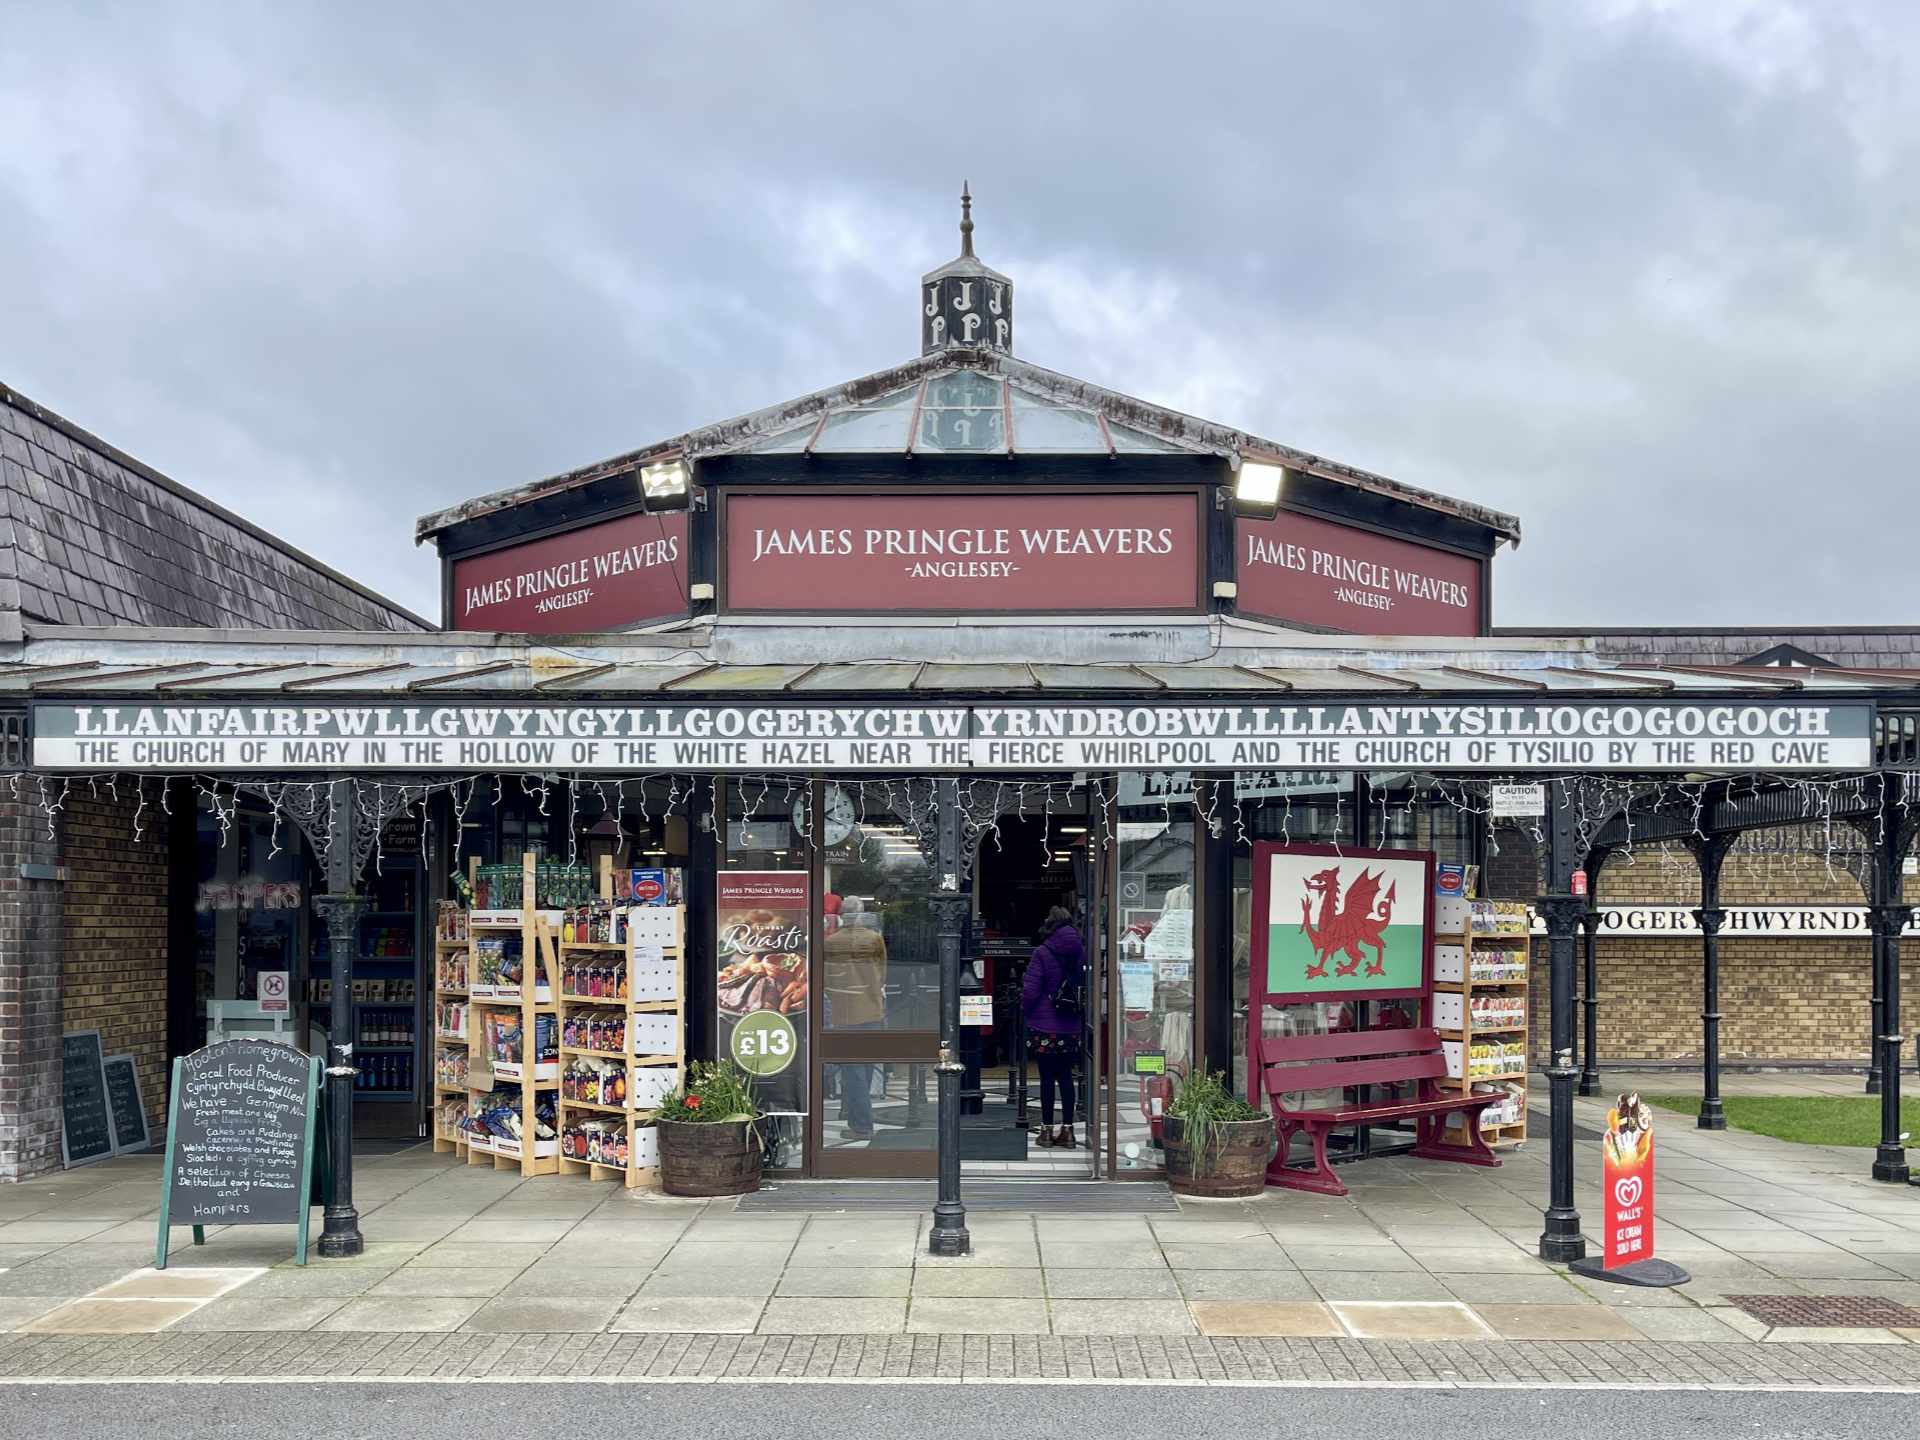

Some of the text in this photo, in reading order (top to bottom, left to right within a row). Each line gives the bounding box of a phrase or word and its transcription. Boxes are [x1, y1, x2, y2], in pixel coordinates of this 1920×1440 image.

[752, 528, 1173, 562] JAMES PRINGLE WEAVERS
[465, 536, 678, 616] JAMES PRINGLE WEAVERS
[1246, 535, 1468, 608] JAMES PRINGLE WEAVERS
[75, 741, 1830, 764] THE CHURCH OF MARY IN THE HOLLOW OF THE WHITE HAZEL NEAR THE FIERCE WHIRLPOOL AND THE CHURCH OF TYSILIO BY THE RED CAVE
[1499, 787, 1538, 795] CAUTION
[722, 887, 804, 896] JAMES PRINGLE WEAVERS
[721, 923, 802, 955] Roasts
[740, 1029, 790, 1056] £13
[193, 1063, 301, 1085] Local Food Producer
[182, 1097, 198, 1111] We
[195, 1109, 220, 1117] Fresh
[222, 1109, 244, 1117] meat
[206, 1127, 298, 1142] Cakes and Puddings
[182, 1143, 296, 1159] Welsh chocolates and Fudge
[177, 1166, 184, 1176] A
[186, 1165, 236, 1177] selection
[238, 1167, 249, 1178] of
[217, 1188, 241, 1197] and
[193, 1203, 250, 1217] Hampers
[1616, 1206, 1643, 1222] WALL'S
[1616, 1224, 1642, 1241] ICE CREAM
